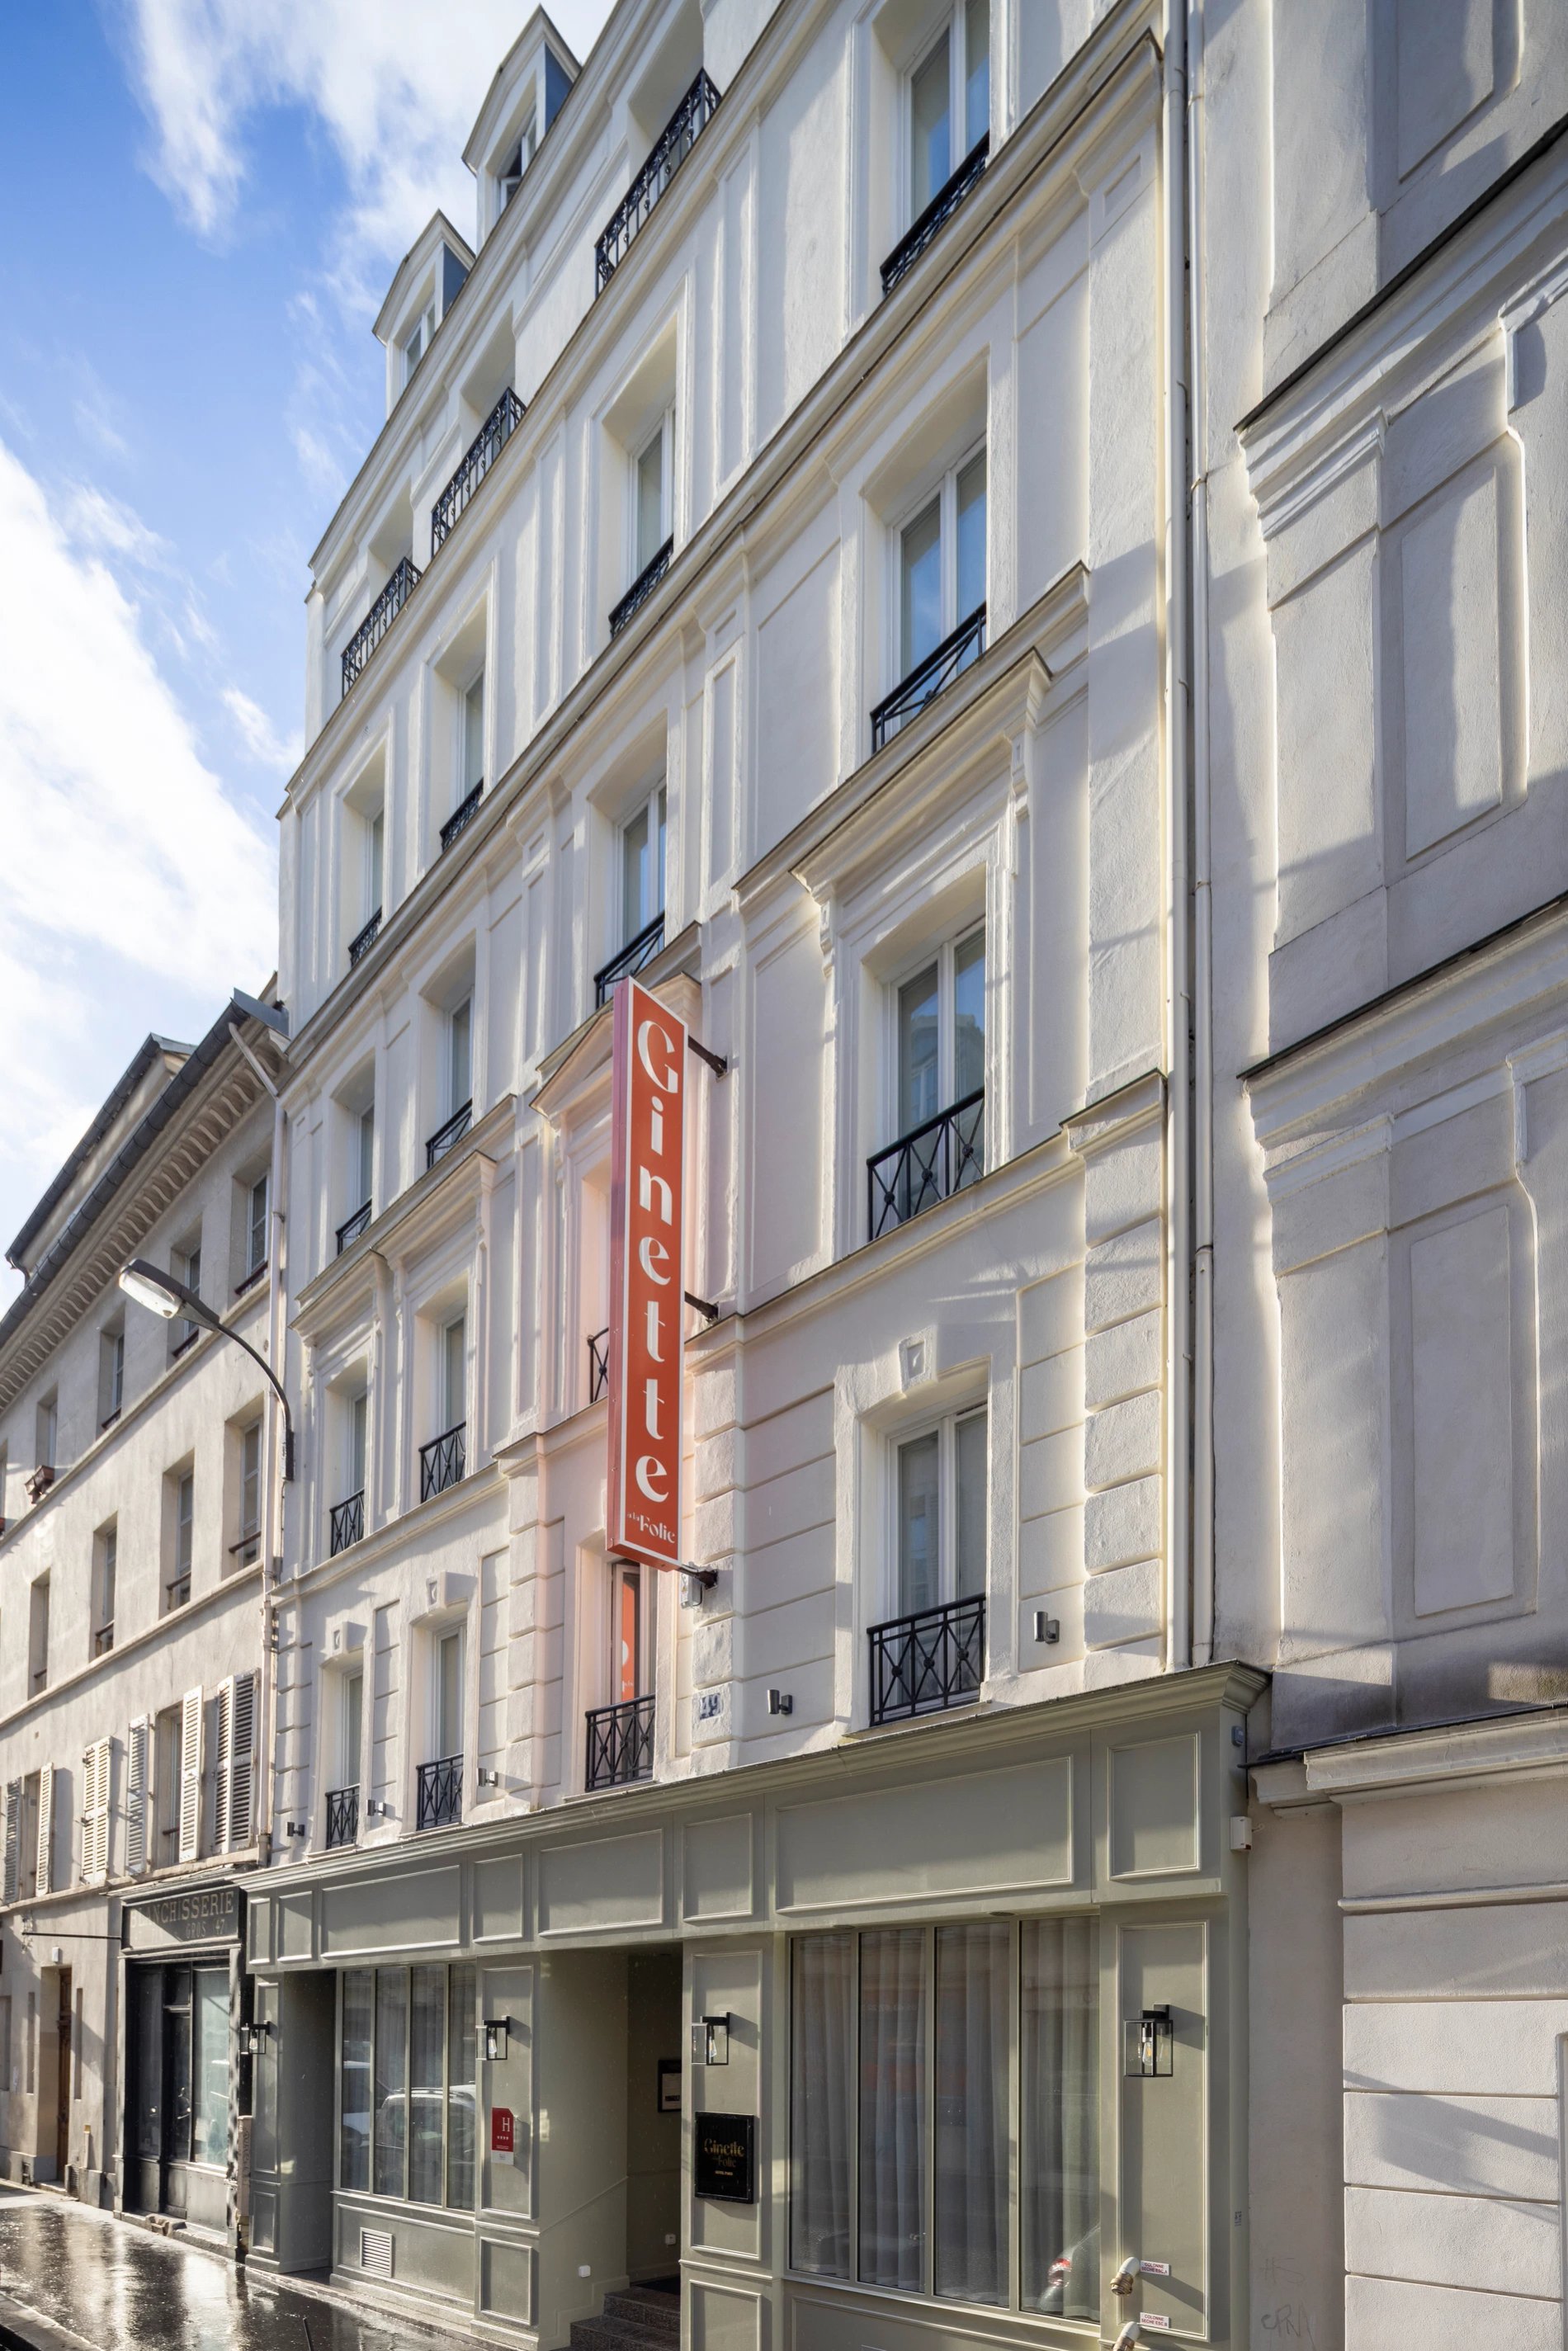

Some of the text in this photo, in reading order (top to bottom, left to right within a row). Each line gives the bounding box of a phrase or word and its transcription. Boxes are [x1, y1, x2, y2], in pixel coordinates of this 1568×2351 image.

[635, 1020, 679, 1503] Ginette
[640, 1514, 675, 1544] Folie
[700, 1693, 720, 1720] 49
[130, 1891, 234, 1928] BLANCHISSERIE
[502, 2117, 510, 2131] H
[704, 2138, 744, 2157] Ginette
